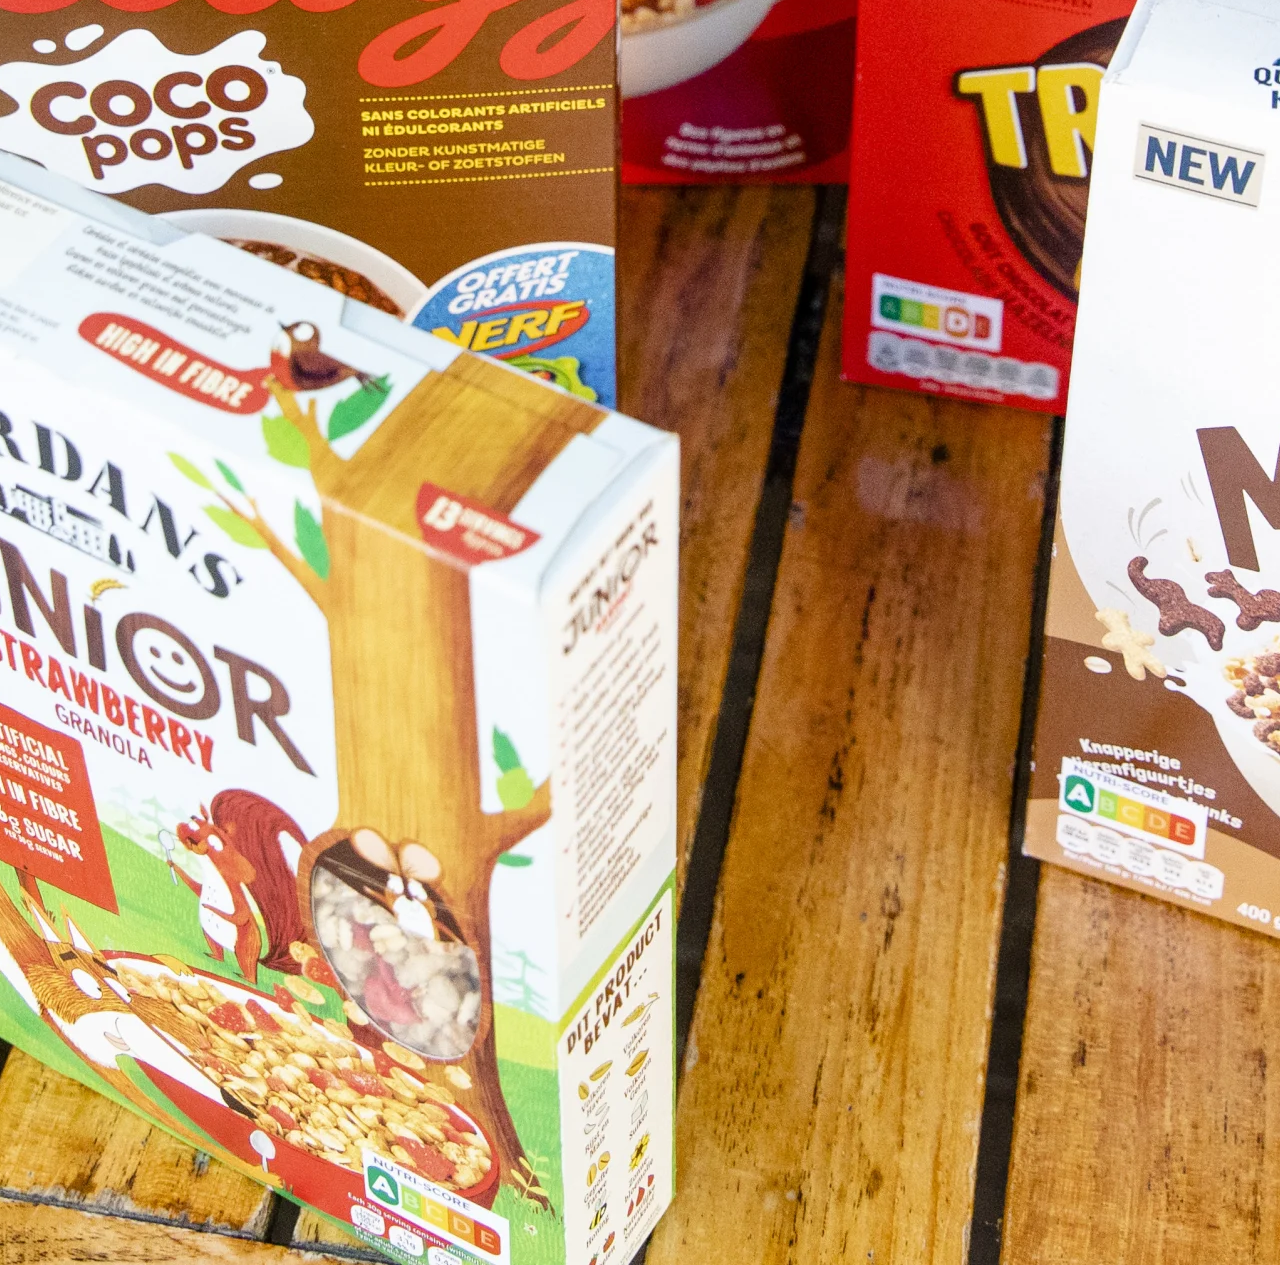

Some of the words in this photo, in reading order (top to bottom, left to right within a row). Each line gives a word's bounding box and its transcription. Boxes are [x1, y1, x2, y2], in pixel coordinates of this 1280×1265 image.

[361, 110, 404, 122] SANS
[406, 105, 506, 120] COLORANTS
[508, 97, 607, 115] ARTIFICIELS
[361, 126, 381, 137] NI
[382, 120, 505, 136] ÉDULCORANTS
[81, 116, 257, 181] pops
[363, 146, 431, 159] ZONDER
[433, 139, 547, 156] KUNSTMATIGE
[364, 161, 426, 174] KLEUR-
[428, 160, 451, 171] OF
[453, 152, 566, 170] ZOETSTOFFEN
[1143, 135, 1256, 197] NEW
[447, 272, 570, 315] GRATIS
[456, 250, 581, 294] OFFERT
[431, 299, 586, 353] NERF
[95, 322, 151, 364] HIGH
[152, 342, 189, 377] IN
[182, 357, 257, 409] FIBRE
[55, 702, 154, 770] GRANOLA
[1079, 737, 1182, 771] Knapperige
[22, 752, 72, 786] COLOURS
[1073, 764, 1170, 806] NUTRI-SCORE
[7, 776, 26, 804] IN
[27, 787, 84, 833] FIBRE
[23, 817, 84, 863] SUGAR
[1237, 902, 1271, 924] 400
[566, 1008, 591, 1055] DIT
[595, 908, 663, 1016] PRODUCT
[372, 1155, 472, 1213] NUTRI-SCORE
